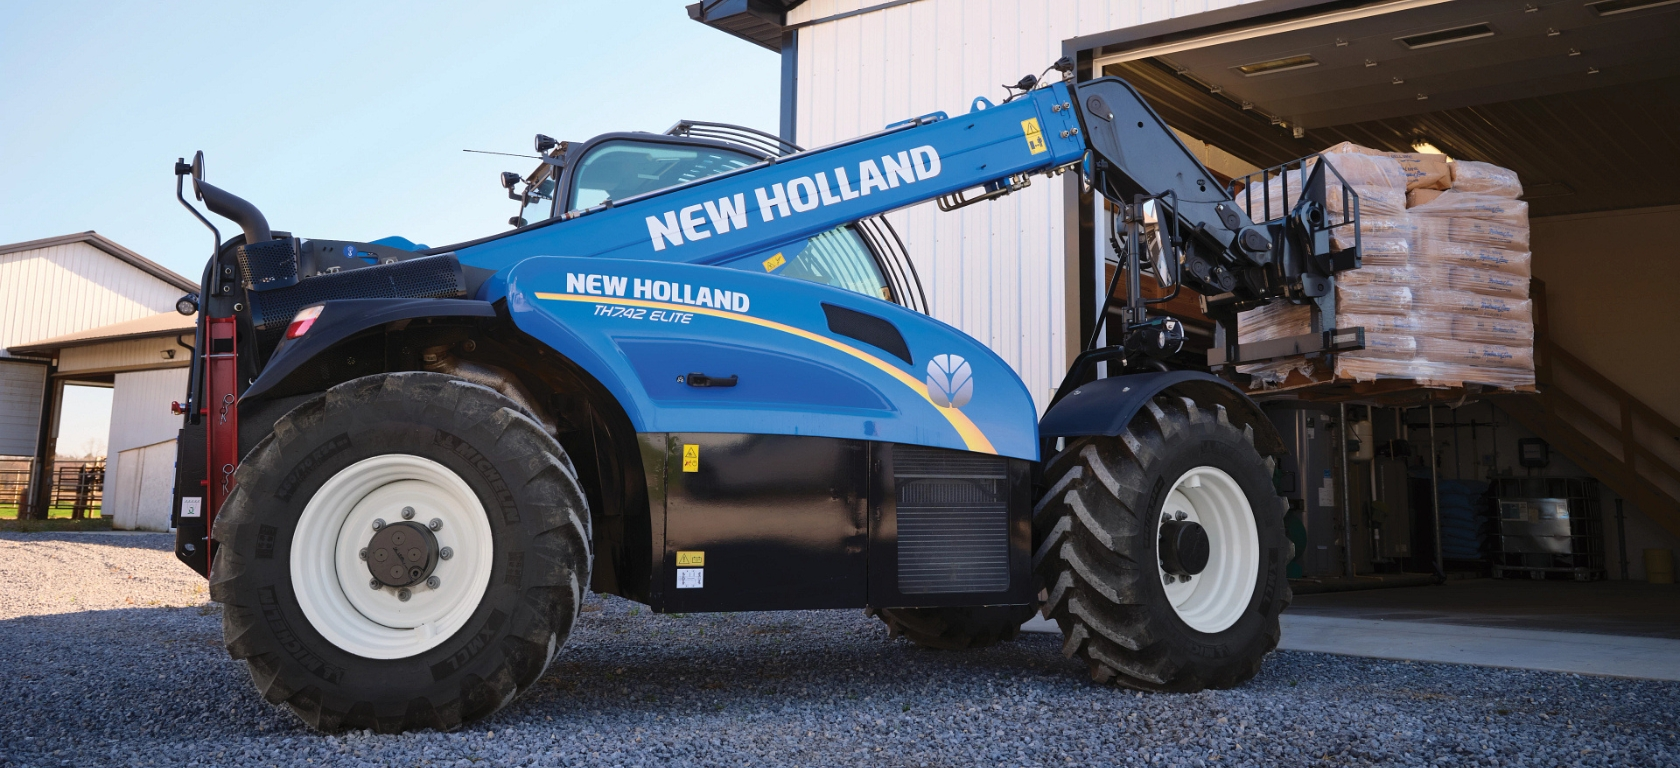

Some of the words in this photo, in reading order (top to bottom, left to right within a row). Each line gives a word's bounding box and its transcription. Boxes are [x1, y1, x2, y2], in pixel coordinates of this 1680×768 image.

[645, 192, 748, 252] NEW
[754, 144, 942, 223] HOLLAND
[566, 272, 628, 297] NEW
[633, 278, 750, 314] HOLLAND
[649, 310, 694, 324] ELITE
[454, 441, 521, 523] MICHELIN
[258, 588, 323, 672] MICHELIN
[446, 622, 496, 670] XMCL
